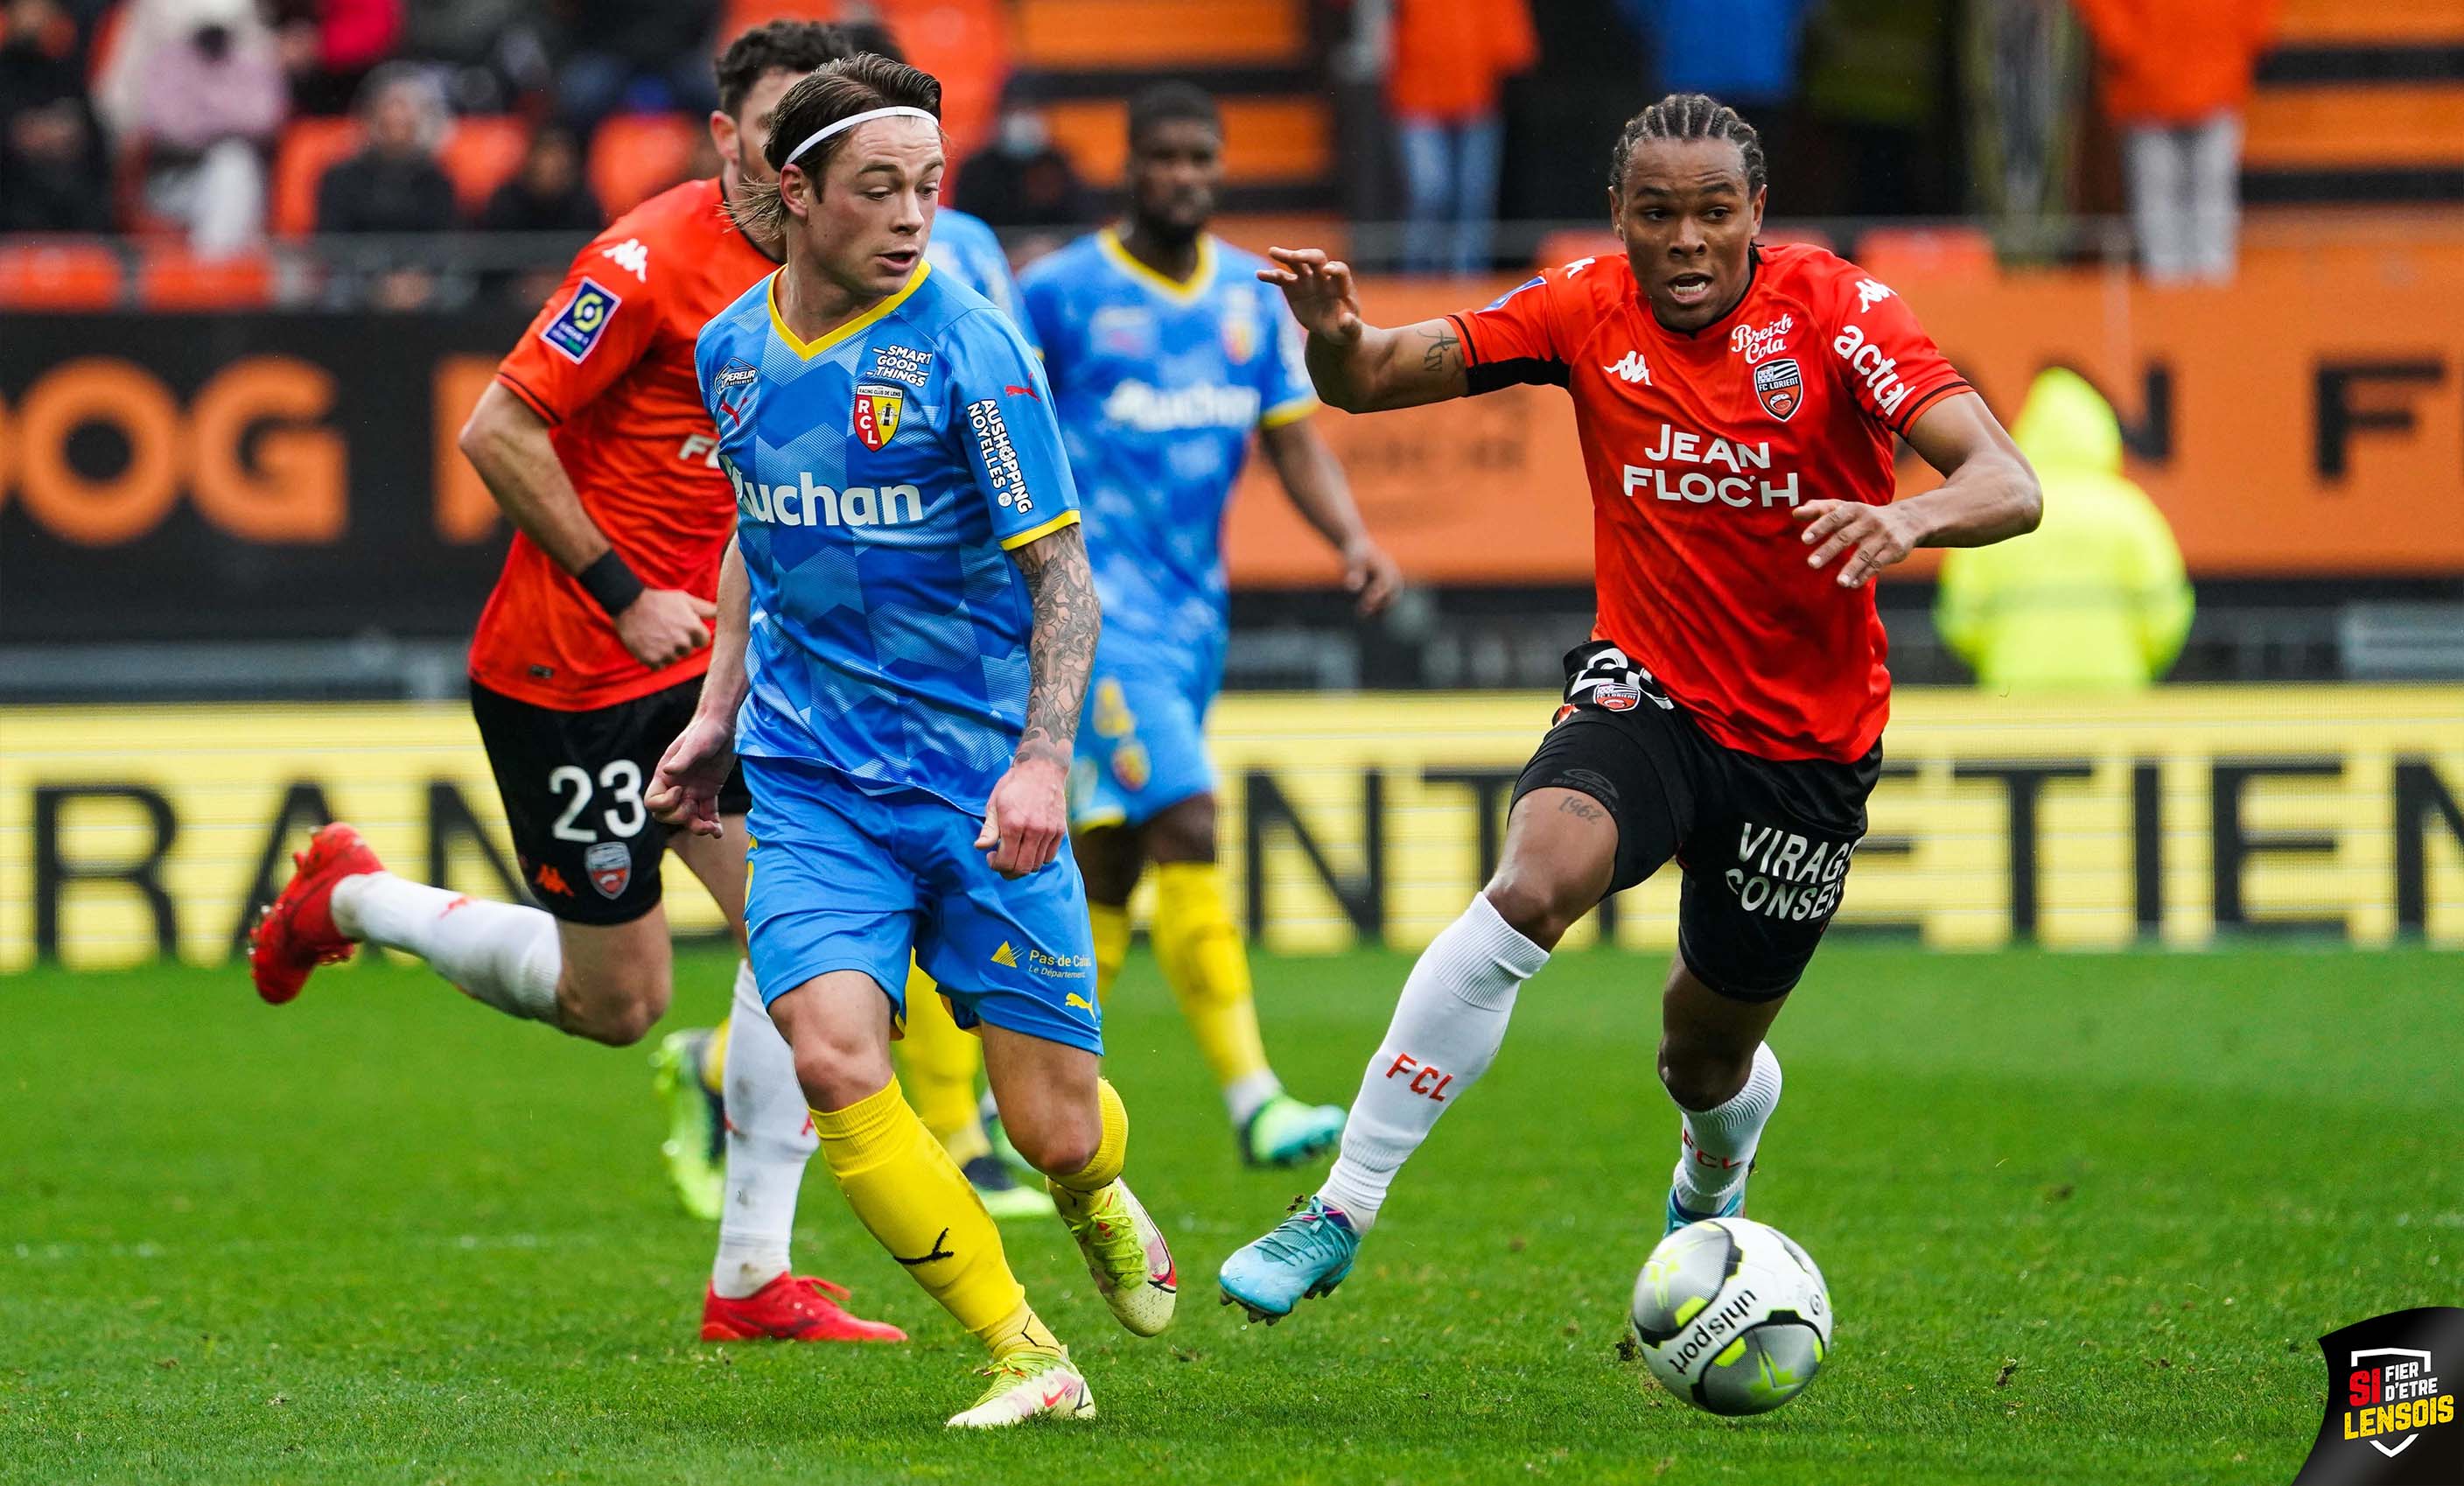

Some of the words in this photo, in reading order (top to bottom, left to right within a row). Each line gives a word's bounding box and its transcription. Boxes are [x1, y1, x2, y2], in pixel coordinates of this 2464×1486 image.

[887, 345, 932, 364] SMART
[1731, 313, 1794, 352] Breizh
[1745, 338, 1787, 364] Cola
[876, 366, 926, 387] THINGS
[877, 354, 918, 372] GOOD
[1758, 383, 1768, 392] FC
[1769, 376, 1799, 390] LORIENT
[2314, 357, 2464, 480] F
[0, 354, 347, 544] OG
[967, 403, 1006, 489] NOYELLES
[1644, 424, 1771, 473] JEAN
[1623, 464, 1799, 508] FLOC'H
[549, 759, 647, 843] 23
[35, 777, 569, 958] RAN
[1028, 964, 1040, 974] Le
[1385, 1053, 1453, 1102] FCL
[1669, 1289, 1758, 1375] uhlsport
